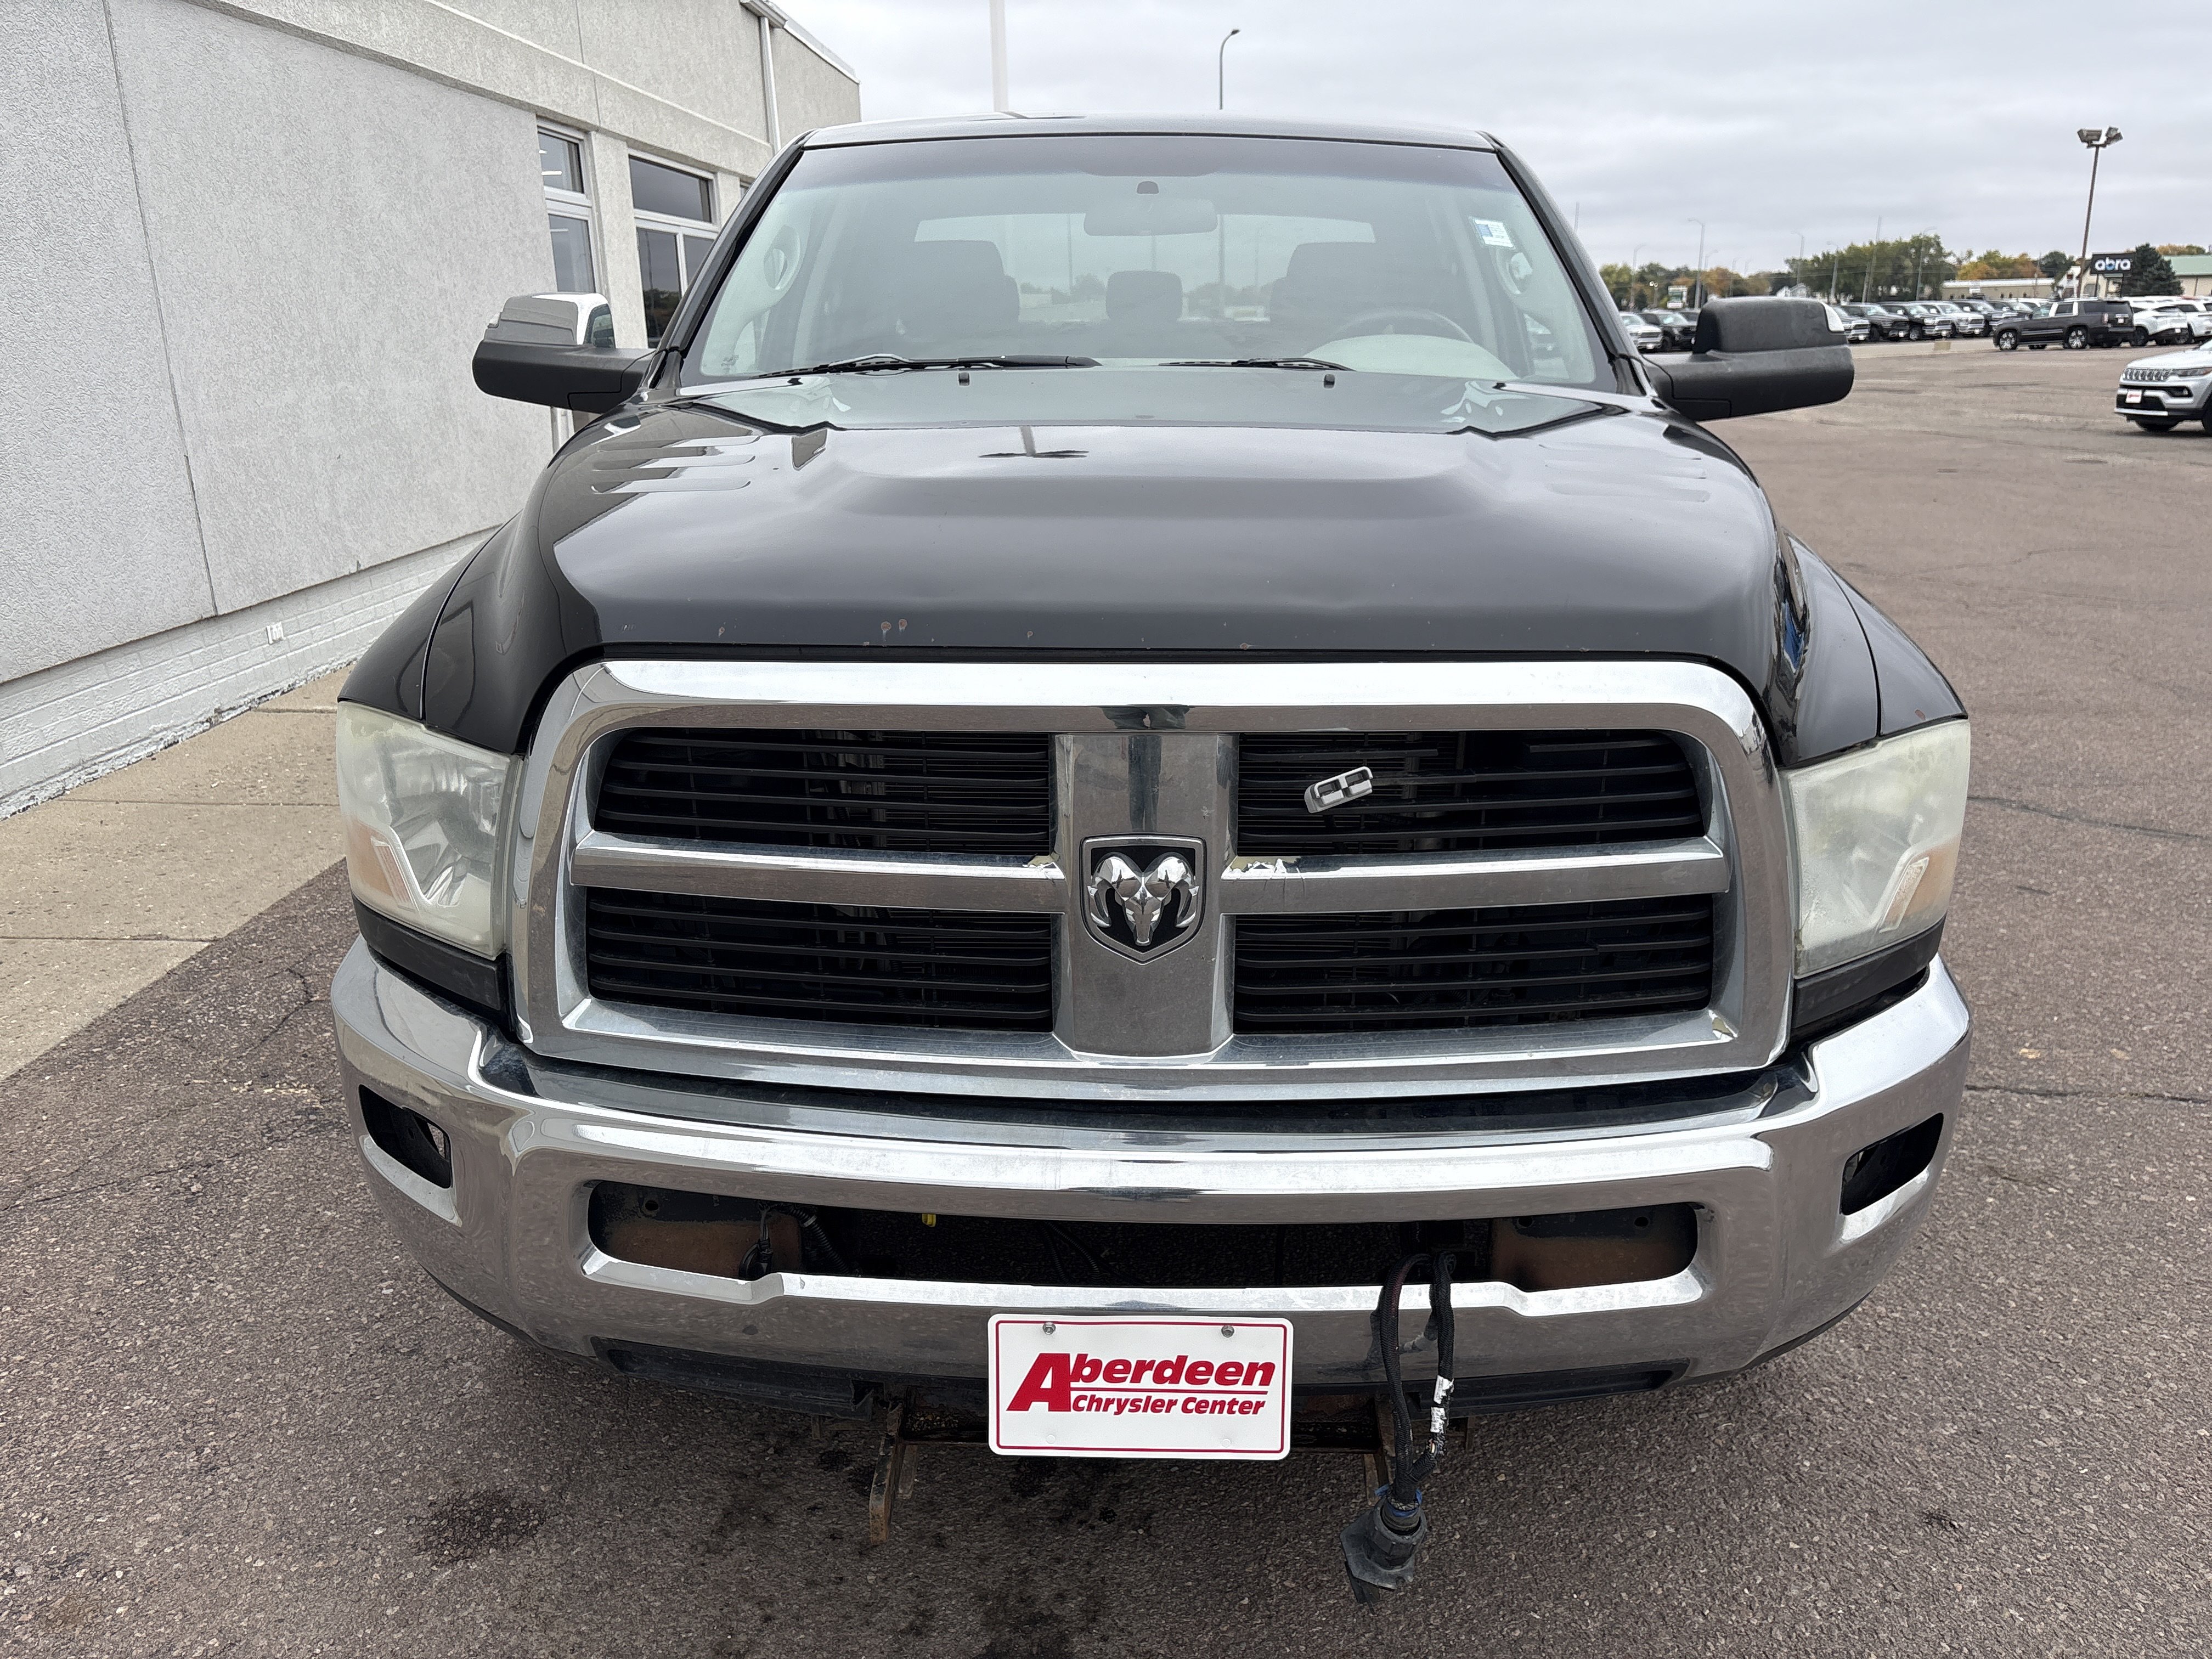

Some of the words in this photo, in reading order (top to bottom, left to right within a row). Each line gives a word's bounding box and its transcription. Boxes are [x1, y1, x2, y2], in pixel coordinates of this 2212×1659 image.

[2095, 256, 2131, 271] abra
[1007, 1352, 1276, 1412] Aberdeen
[1071, 1394, 1178, 1416] Chrysler
[1181, 1396, 1266, 1415] Center
